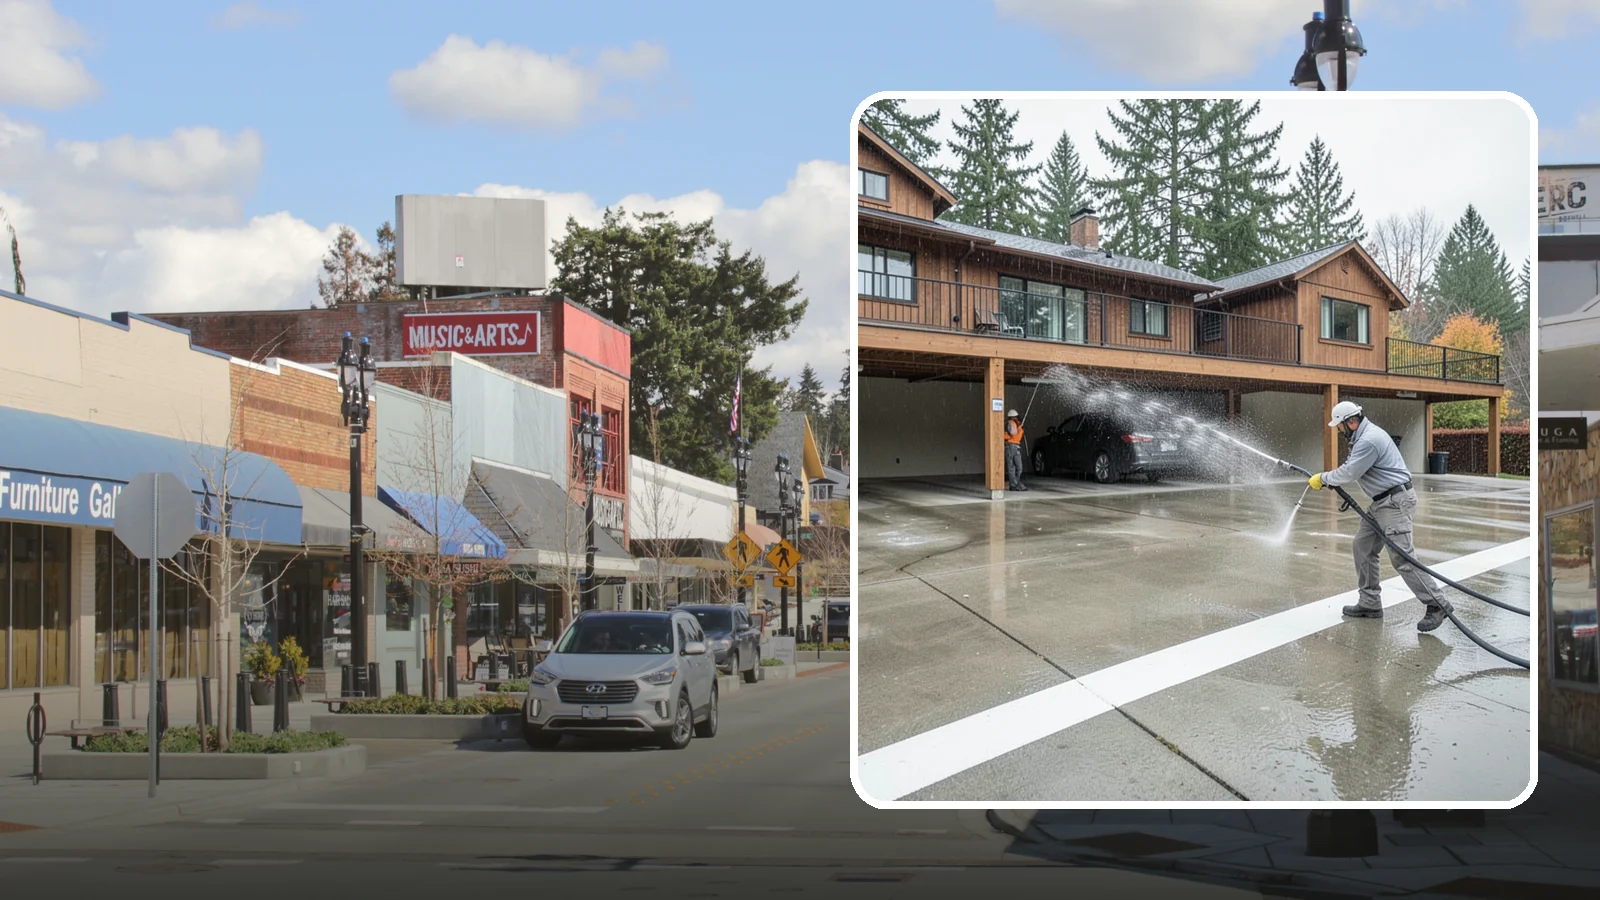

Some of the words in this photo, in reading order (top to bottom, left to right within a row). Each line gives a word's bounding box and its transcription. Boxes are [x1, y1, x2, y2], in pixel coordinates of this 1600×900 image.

[408, 322, 520, 349] MUSIC&ARTS
[1540, 427, 1577, 436] UGA
[0, 471, 79, 515] Furniture
[89, 482, 121, 519] Gal
